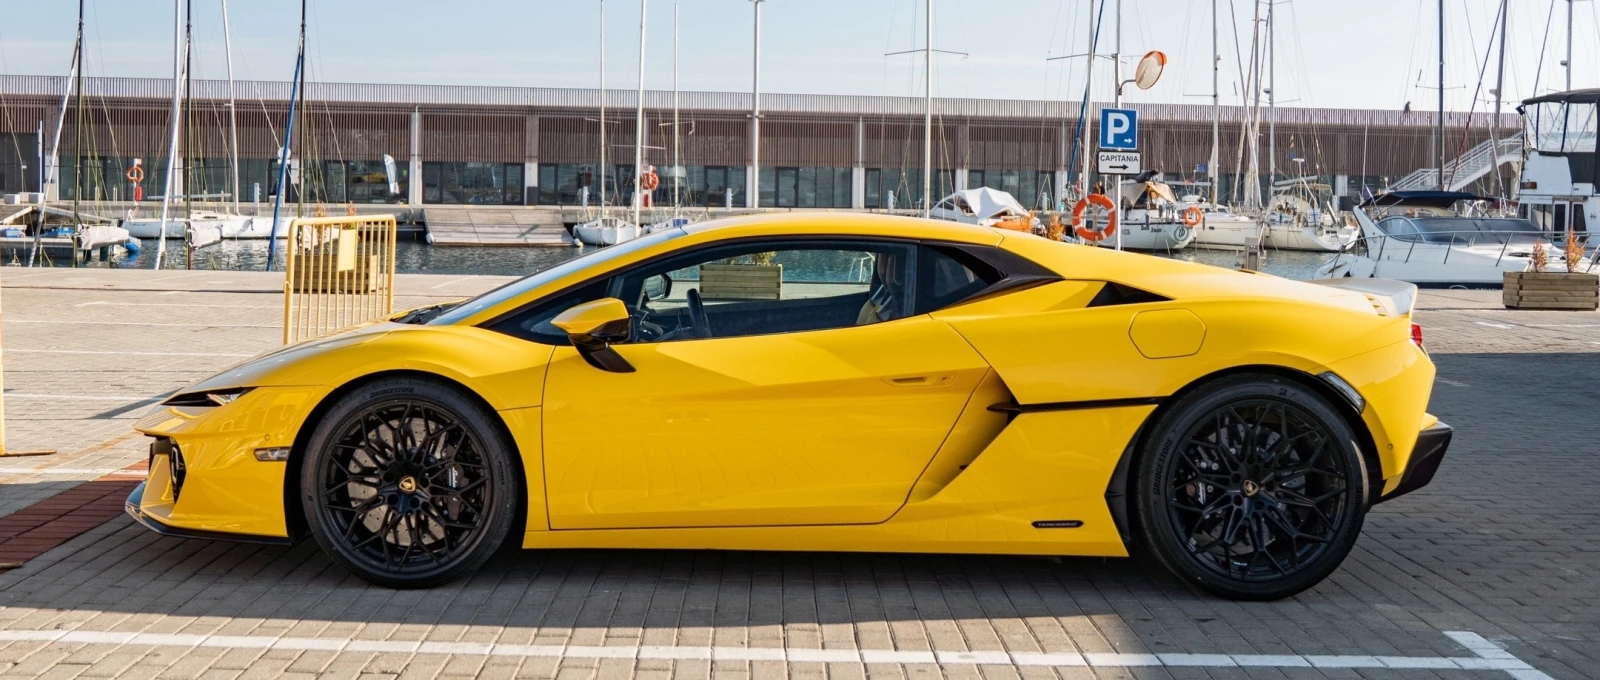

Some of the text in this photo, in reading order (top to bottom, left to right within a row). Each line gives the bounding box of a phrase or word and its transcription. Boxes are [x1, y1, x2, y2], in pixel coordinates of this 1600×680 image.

[1107, 112, 1130, 145] P
[369, 386, 414, 398] BRIDGESTONE
[1153, 438, 1173, 496] BRIDGESTONE
